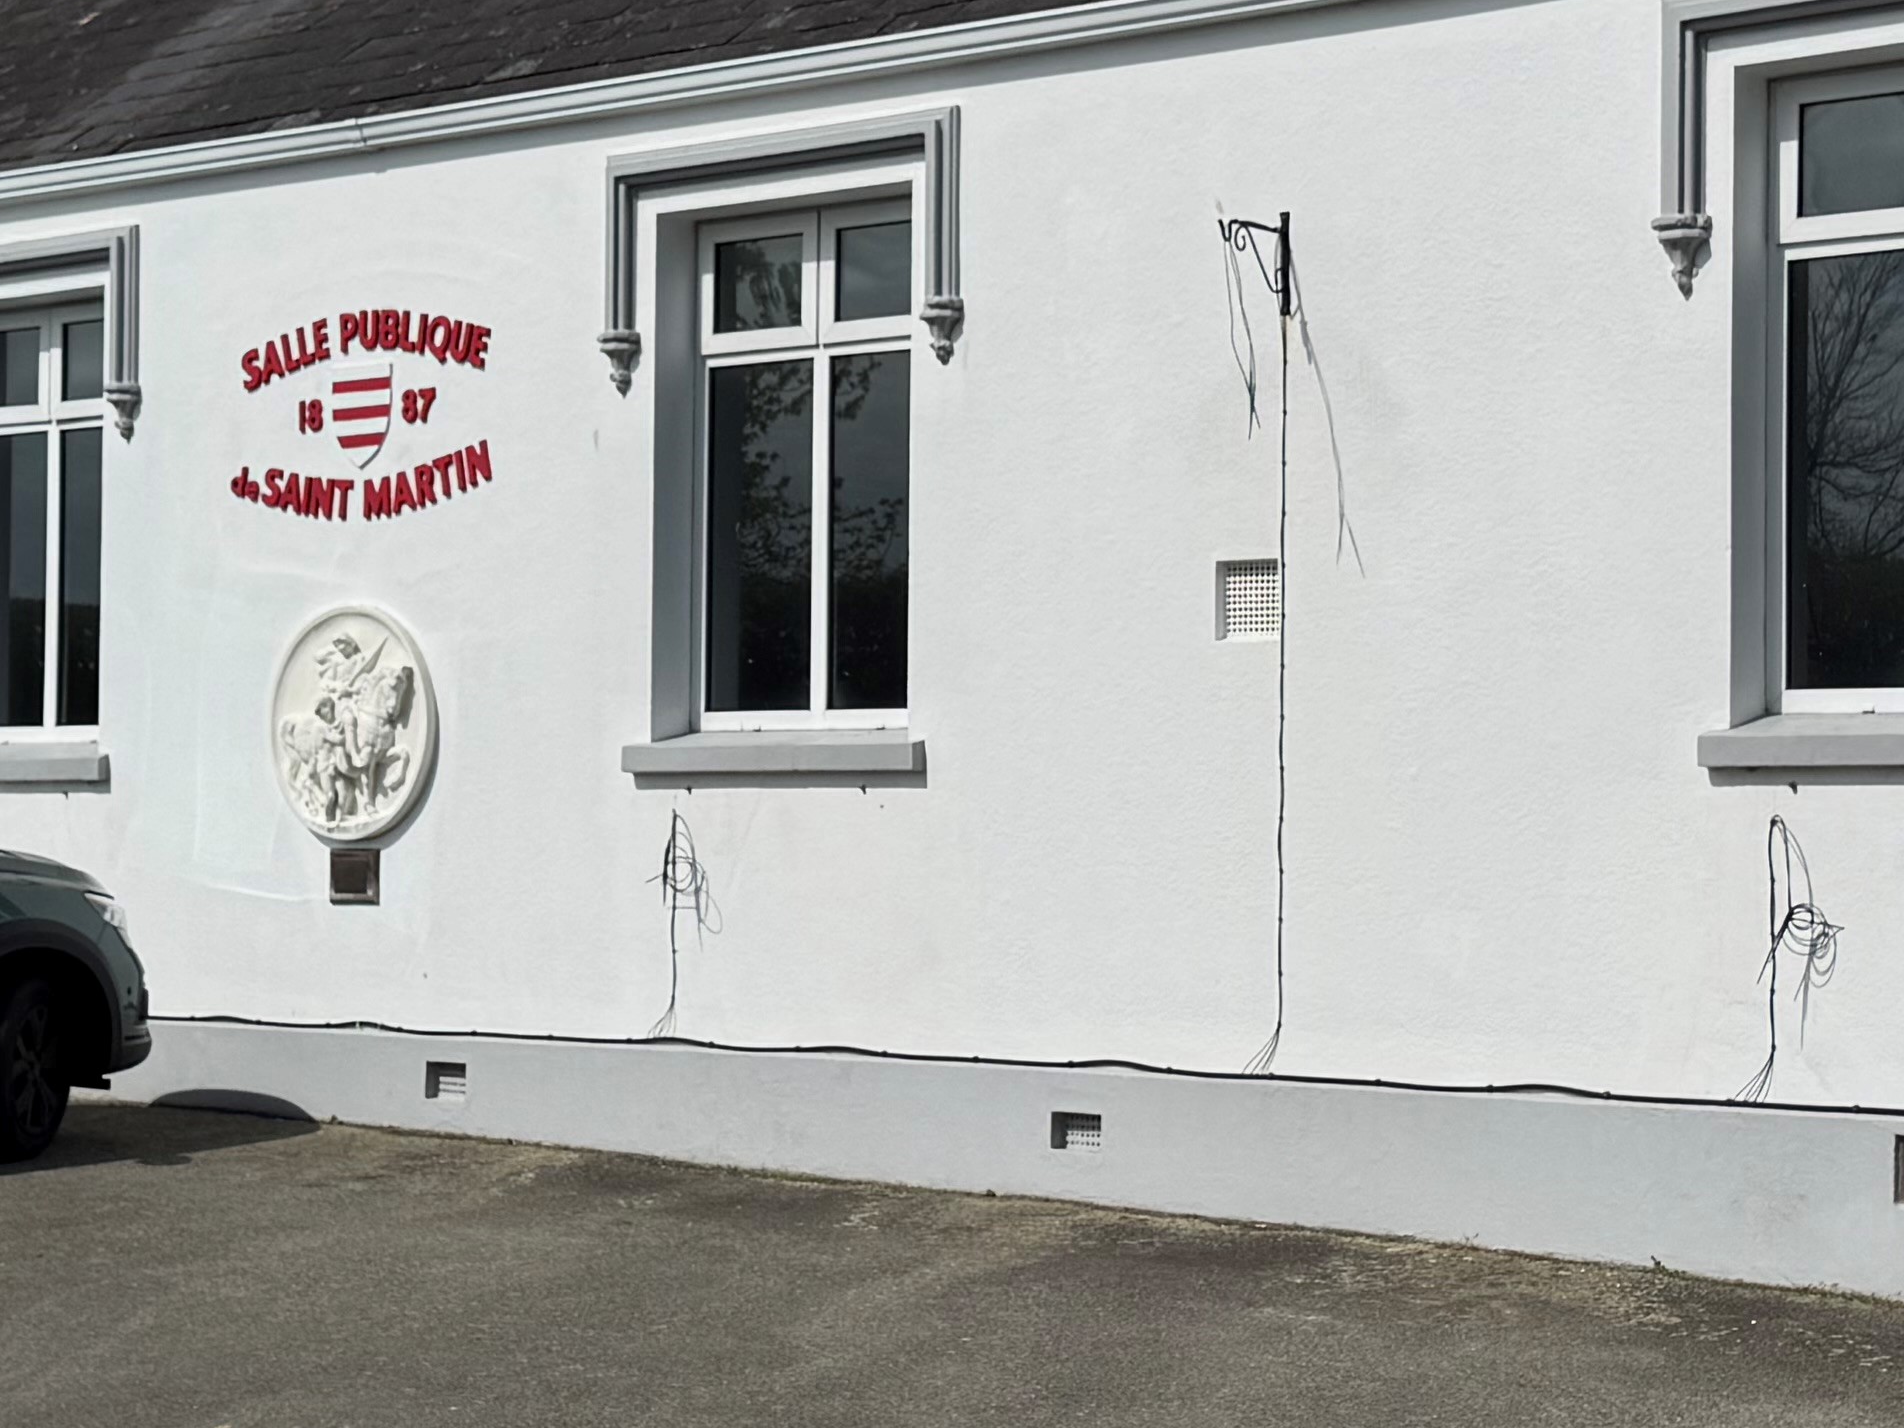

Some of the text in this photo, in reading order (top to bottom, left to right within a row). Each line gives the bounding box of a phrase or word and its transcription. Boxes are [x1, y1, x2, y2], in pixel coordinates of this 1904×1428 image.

[241, 309, 492, 393] SALLE PUBLIQUE
[298, 387, 437, 435] 18 87
[230, 439, 494, 522] de SAINT MARTIN
